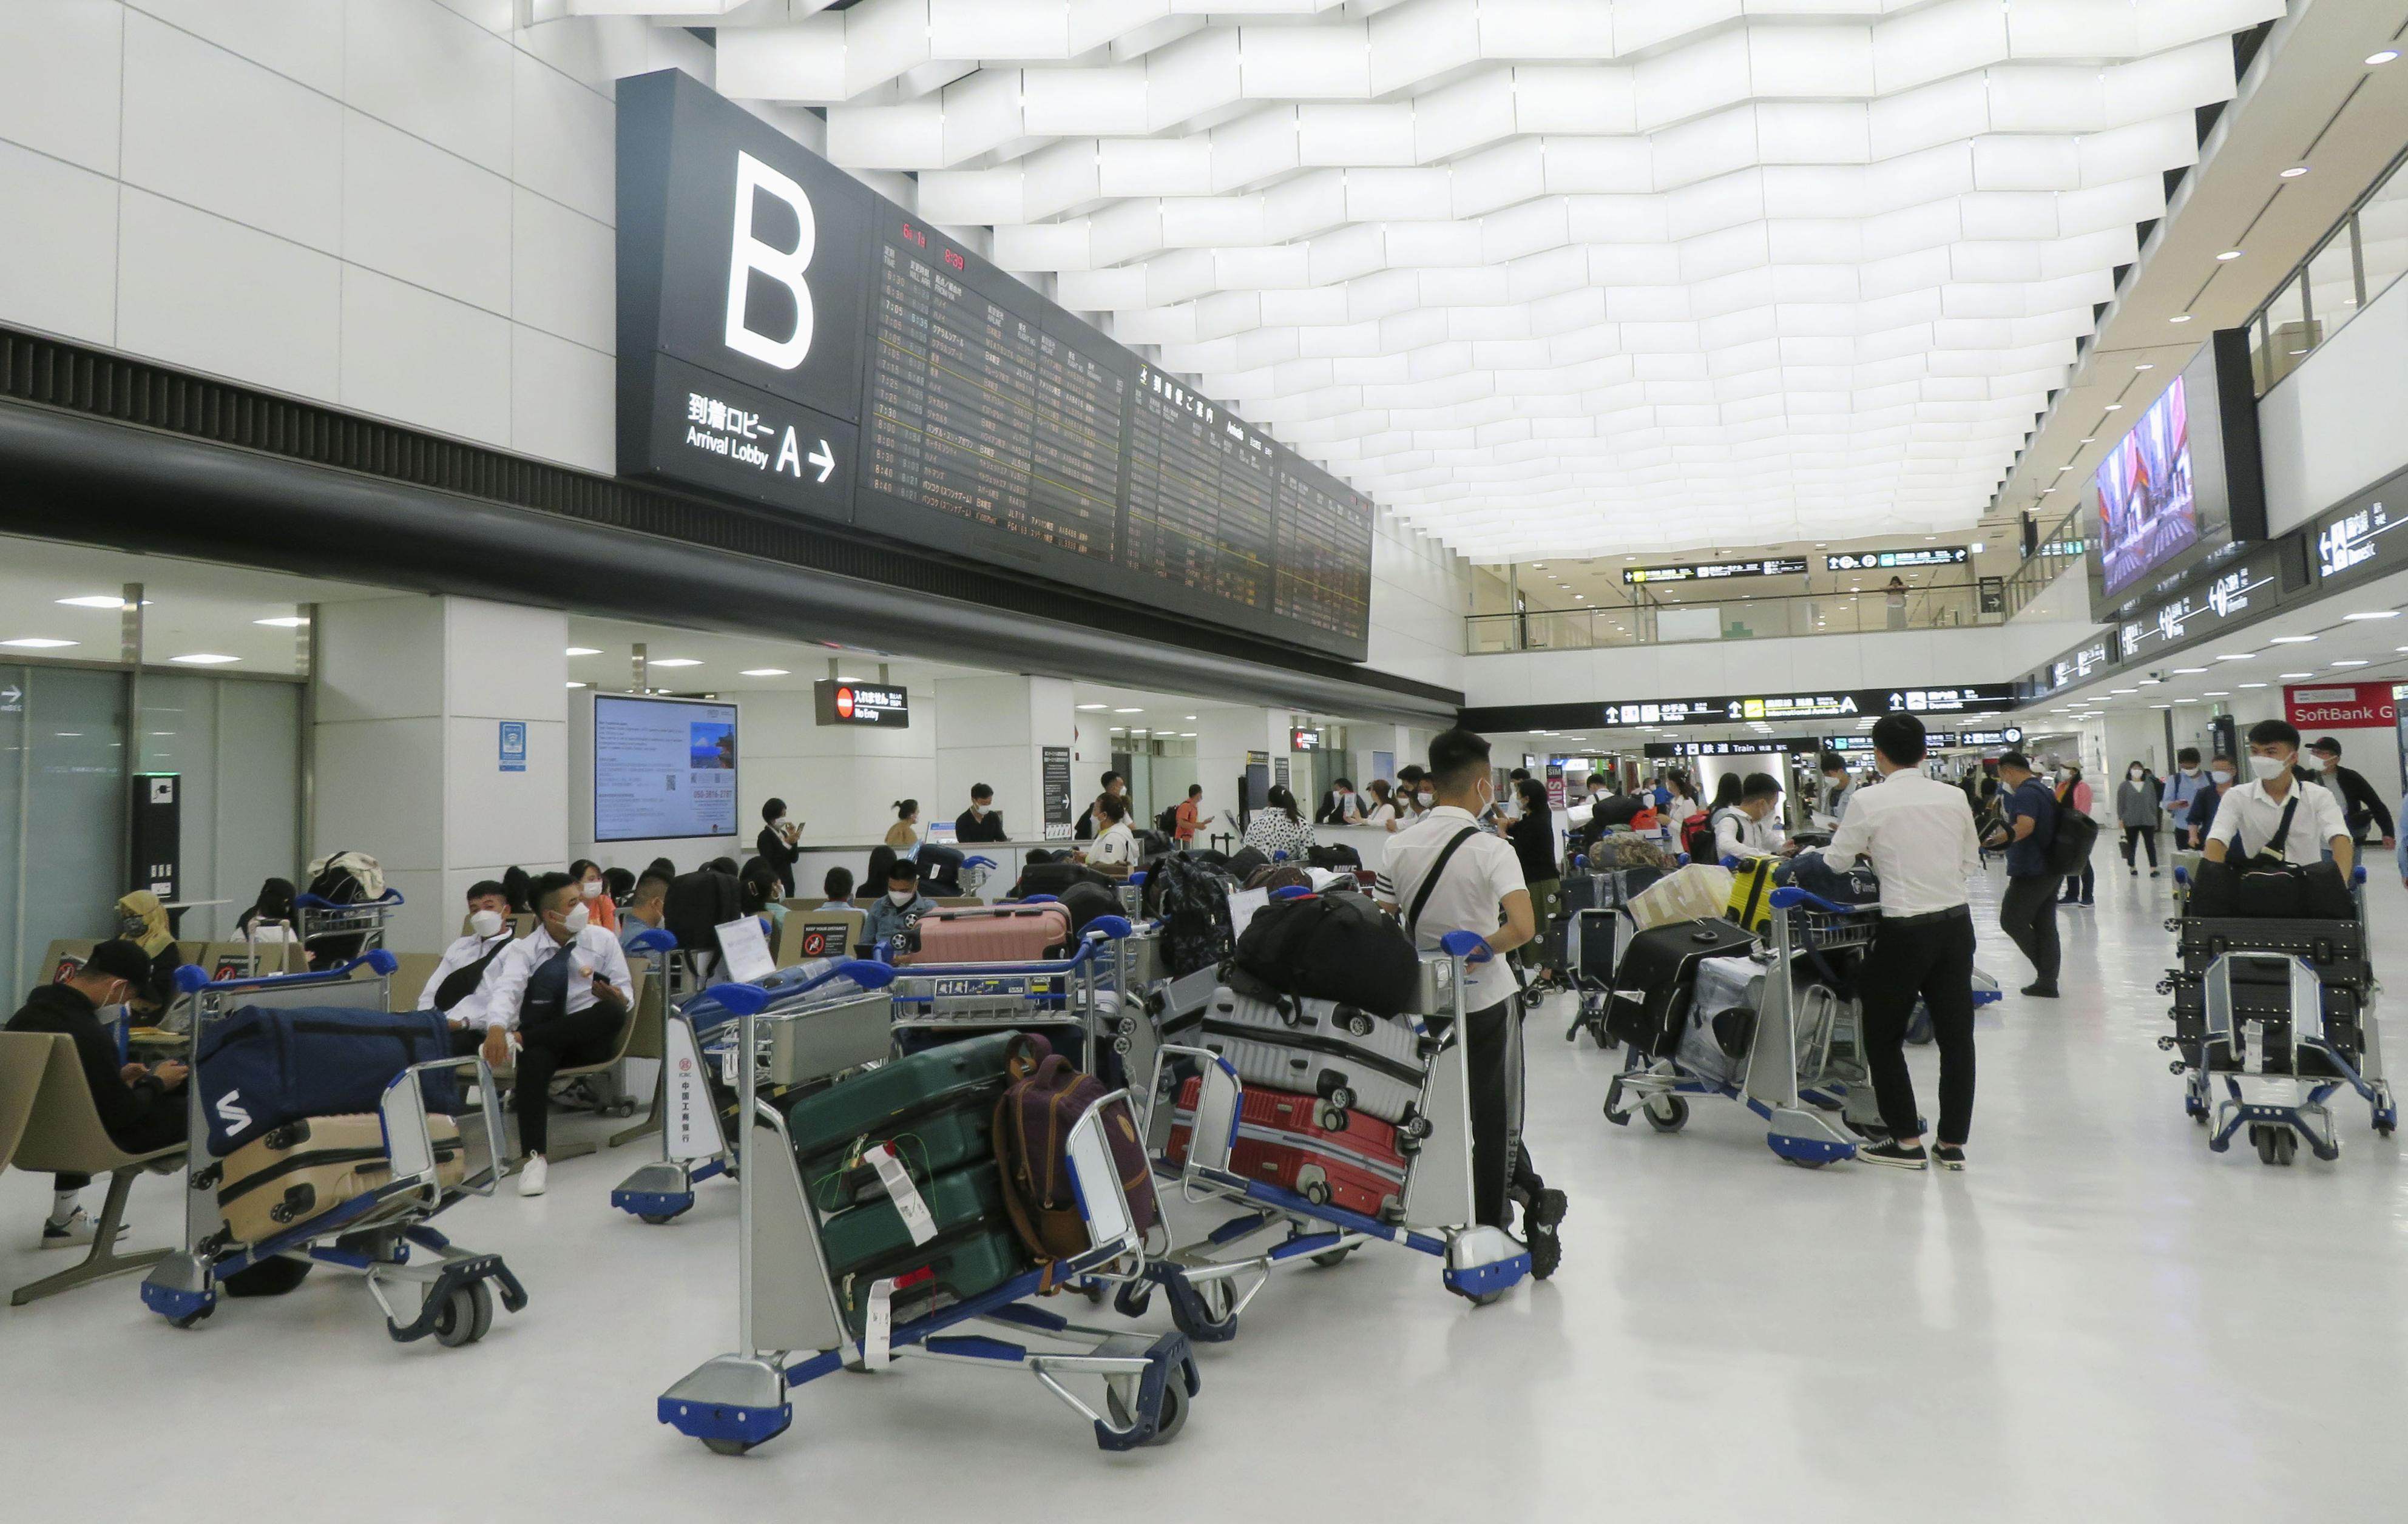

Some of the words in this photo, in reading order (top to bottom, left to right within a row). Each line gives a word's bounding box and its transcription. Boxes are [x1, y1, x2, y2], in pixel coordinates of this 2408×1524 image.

[725, 150, 816, 370] B
[944, 248, 964, 270] 8:39
[885, 300, 904, 317] 7:05
[911, 313, 928, 329] 6:35
[1015, 366, 1033, 381] JL724
[882, 345, 901, 360] 7:05
[881, 359, 900, 375] 7:15
[880, 374, 899, 389] 7:25
[879, 389, 898, 404] 7:25
[1153, 374, 1214, 423] 到着便ご案内
[688, 393, 774, 440] 到着ロビー
[878, 404, 897, 419] 7:30
[876, 419, 896, 433] 8:00
[876, 434, 895, 448] 8:00
[686, 428, 729, 457] Arrival
[731, 442, 769, 471] Lobby
[776, 426, 801, 478] A
[874, 449, 894, 463] 8:30
[873, 464, 893, 477] 8:40
[872, 479, 892, 491] 8:40
[2348, 541, 2376, 565] Domestic
[854, 690, 889, 705] 入れません
[1840, 696, 1859, 713] A
[854, 708, 864, 718] No
[864, 709, 879, 721] Entry
[1765, 708, 1812, 716] International
[2295, 707, 2374, 722] SoftBank
[1703, 743, 1729, 754] 鉄道
[1548, 781, 1563, 808] SIM
